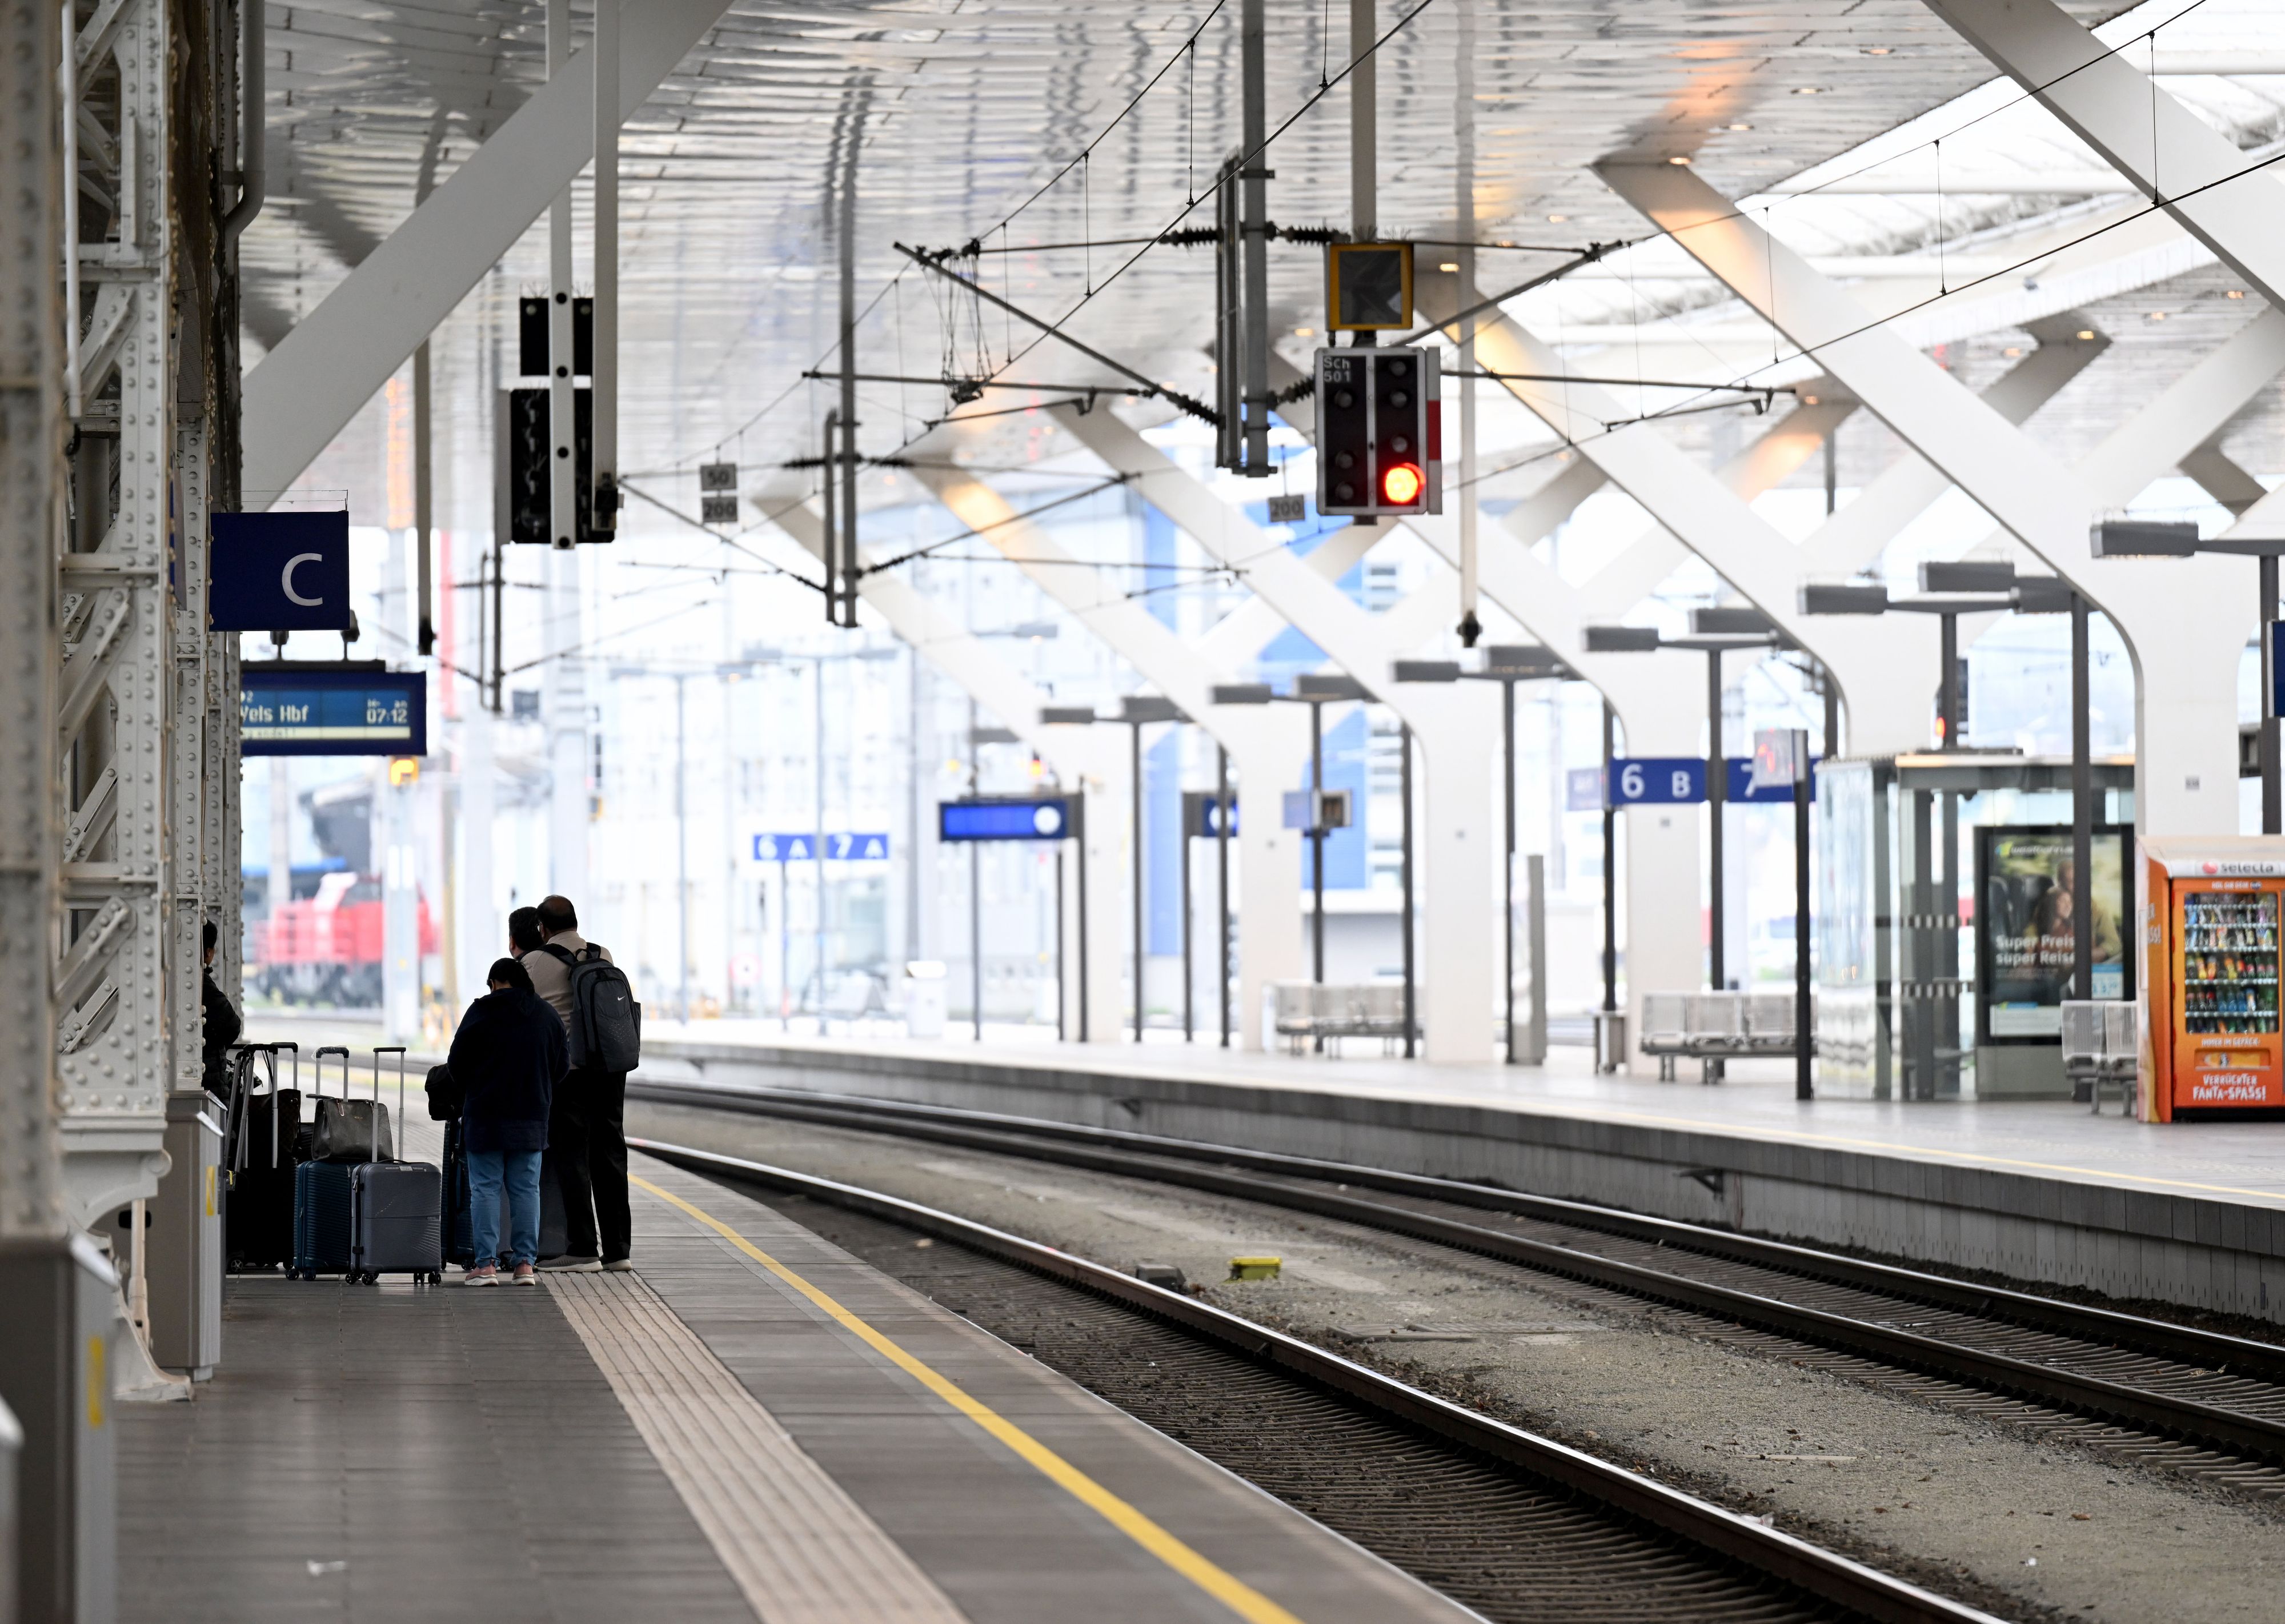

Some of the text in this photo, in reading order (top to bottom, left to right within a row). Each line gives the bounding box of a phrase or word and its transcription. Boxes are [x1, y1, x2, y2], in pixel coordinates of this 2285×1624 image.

[1324, 370, 1350, 382] 501
[708, 468, 730, 486] 50
[703, 501, 737, 518] 200
[1270, 500, 1302, 518] 200
[282, 552, 323, 607] C
[280, 704, 309, 723] Hbf
[366, 708, 408, 724] 07:12
[1621, 763, 1645, 799] 6
[1671, 770, 1691, 799] B
[758, 834, 808, 860] 6 A
[833, 833, 884, 859] 7 A
[1996, 934, 2038, 951] Super
[1995, 952, 2036, 968] super
[2192, 1085, 2267, 1101] FANTA-SPASS!
